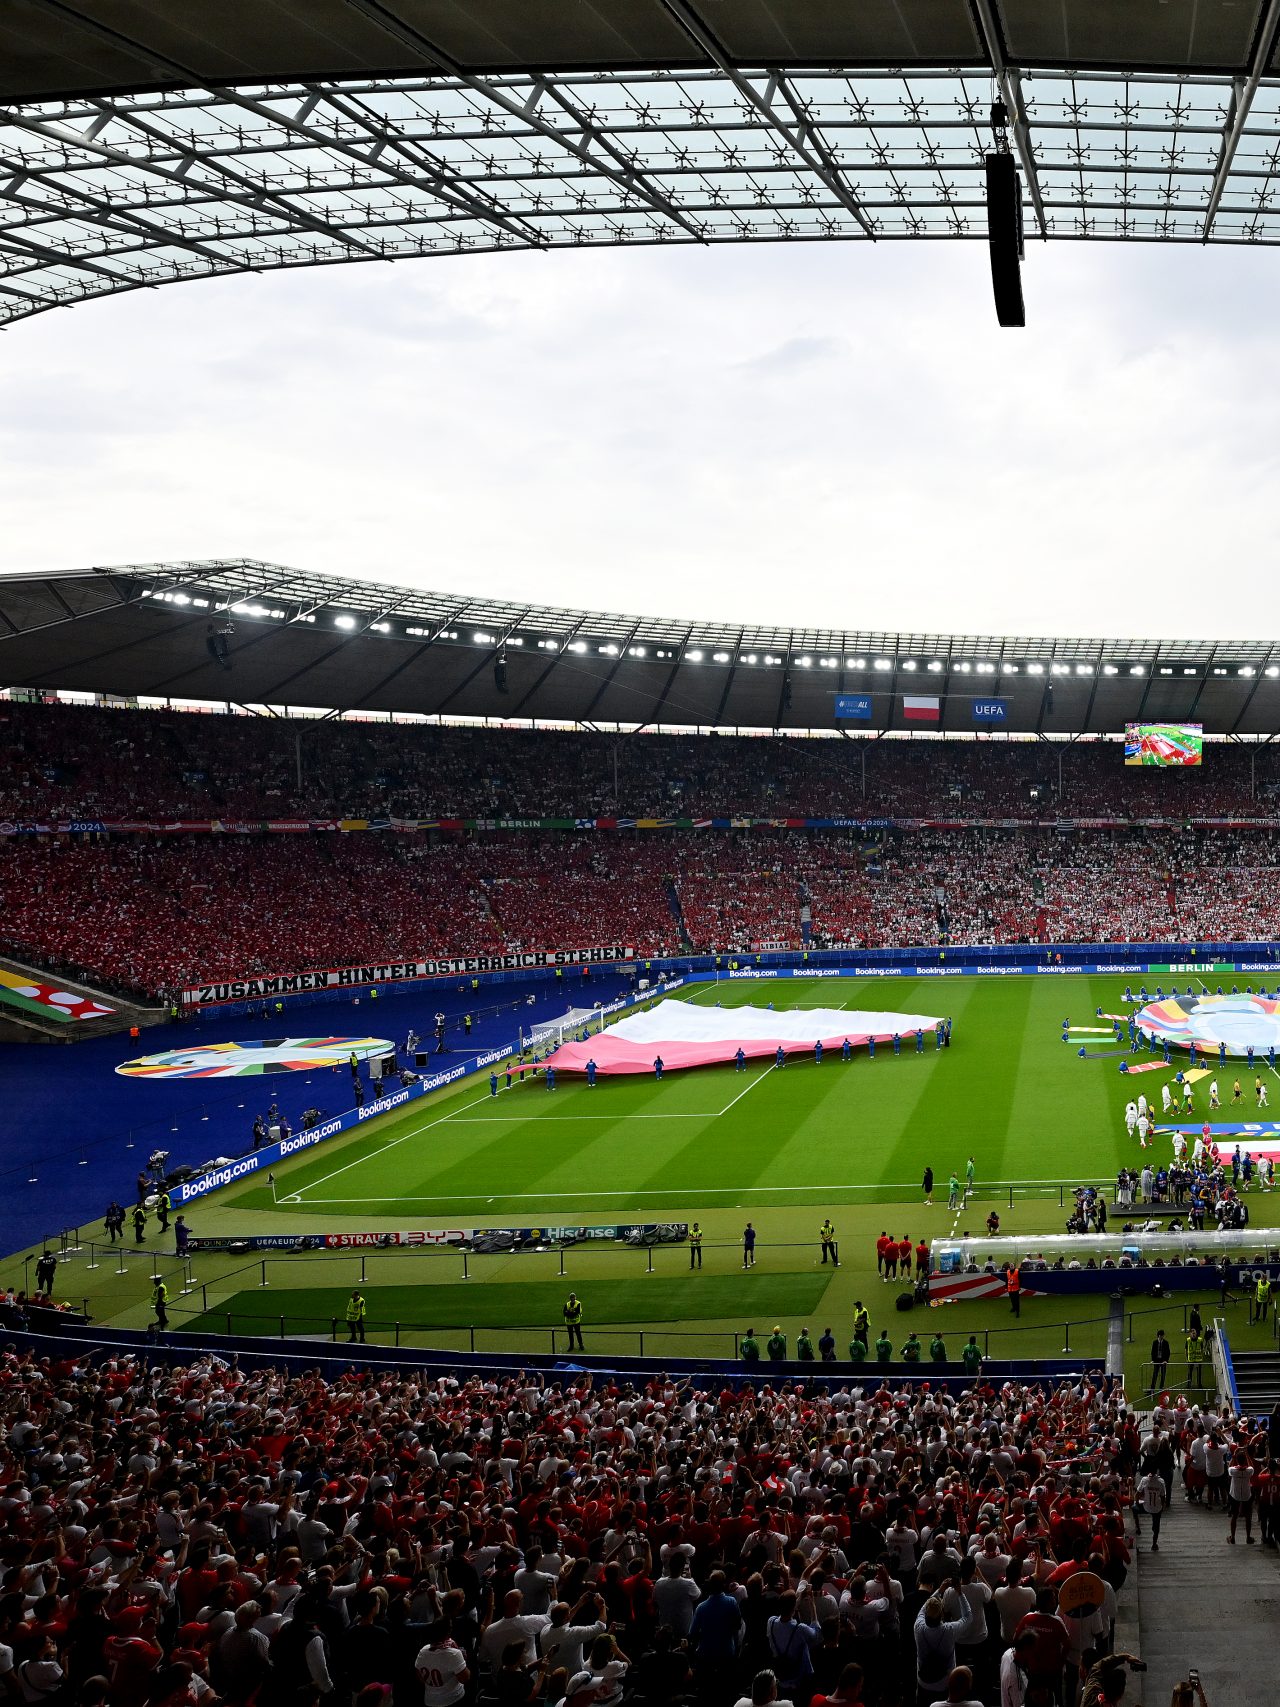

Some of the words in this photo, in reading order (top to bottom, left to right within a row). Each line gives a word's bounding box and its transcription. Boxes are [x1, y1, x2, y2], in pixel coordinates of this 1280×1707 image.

[976, 706, 1004, 714] UEFA
[730, 970, 777, 978] Booking.com
[793, 968, 840, 977] Booking.com
[855, 968, 901, 976] Booking.com
[916, 967, 962, 975] Booking.com
[977, 966, 1022, 974] Booking.com
[1037, 966, 1082, 974] Booking.com
[1097, 965, 1141, 973] Booking.com
[1169, 964, 1214, 972] BERLIN
[199, 972, 328, 1004] ZUSAMMEN
[338, 962, 418, 986] HINTER
[424, 952, 547, 976] ÖSTERREICH
[554, 946, 626, 965] STEHEN
[634, 988, 657, 1002] Booking.com
[522, 1028, 554, 1047] Booking.com
[476, 1046, 513, 1067] Booking.com
[424, 1066, 466, 1092] Booking.com
[358, 1090, 409, 1120] Booking.com
[280, 1120, 342, 1155] Booking.com
[182, 1156, 258, 1200] Booking.com
[341, 1234, 397, 1244] STRAUS
[408, 1231, 464, 1243] BYD
[108, 1658, 119, 1684] 7
[420, 1666, 444, 1688] 20
